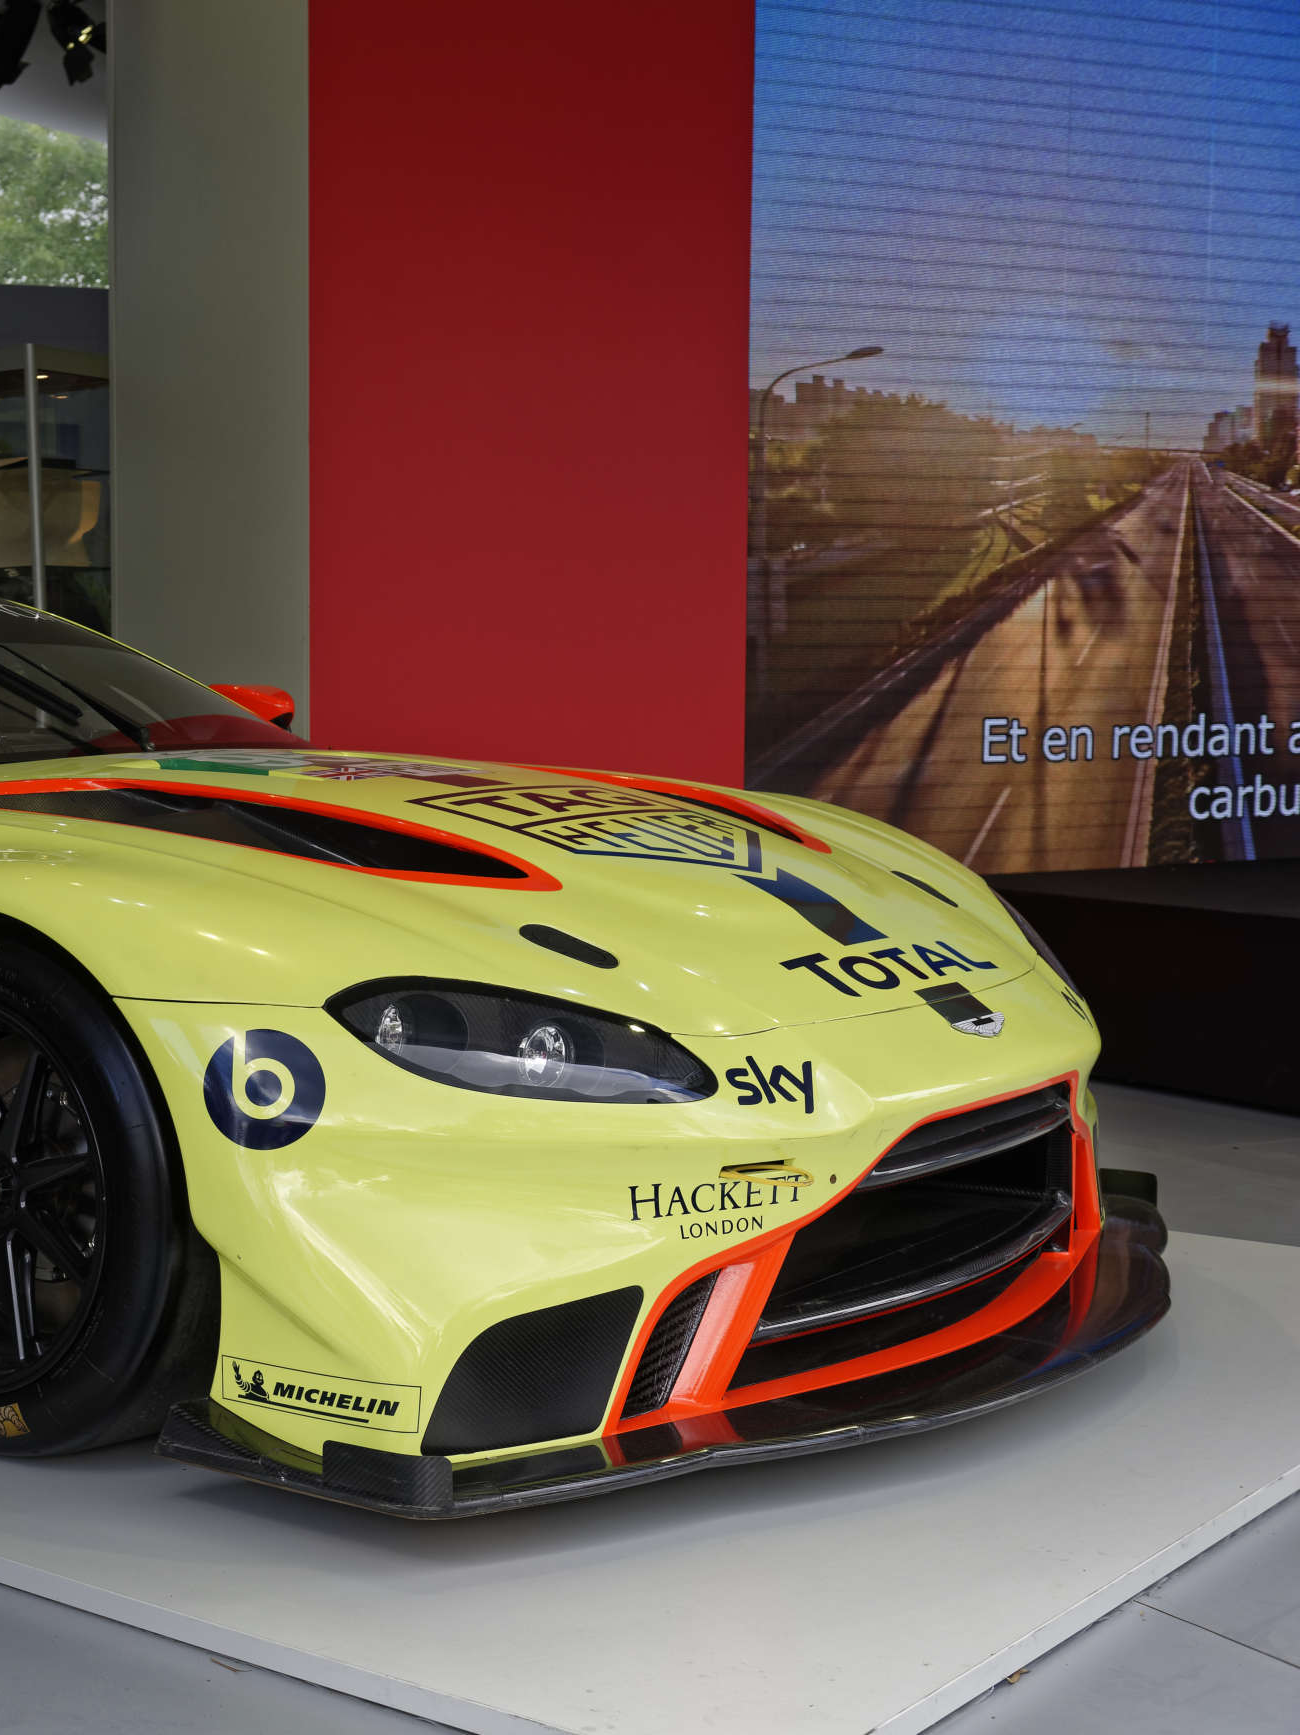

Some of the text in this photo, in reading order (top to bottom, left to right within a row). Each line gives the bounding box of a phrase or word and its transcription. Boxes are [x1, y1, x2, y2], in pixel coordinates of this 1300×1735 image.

[982, 717, 1028, 764] Et
[1042, 725, 1094, 761] en
[1111, 713, 1275, 759] rendant
[454, 789, 648, 817] TAG
[1188, 774, 1300, 820] carbu
[542, 814, 736, 861] HEUER
[780, 939, 1000, 997] TOTAL
[726, 1055, 814, 1114] sky
[628, 1174, 806, 1222] HACKETT
[680, 1215, 763, 1240] LONDON
[272, 1379, 401, 1418] MICHELIN
